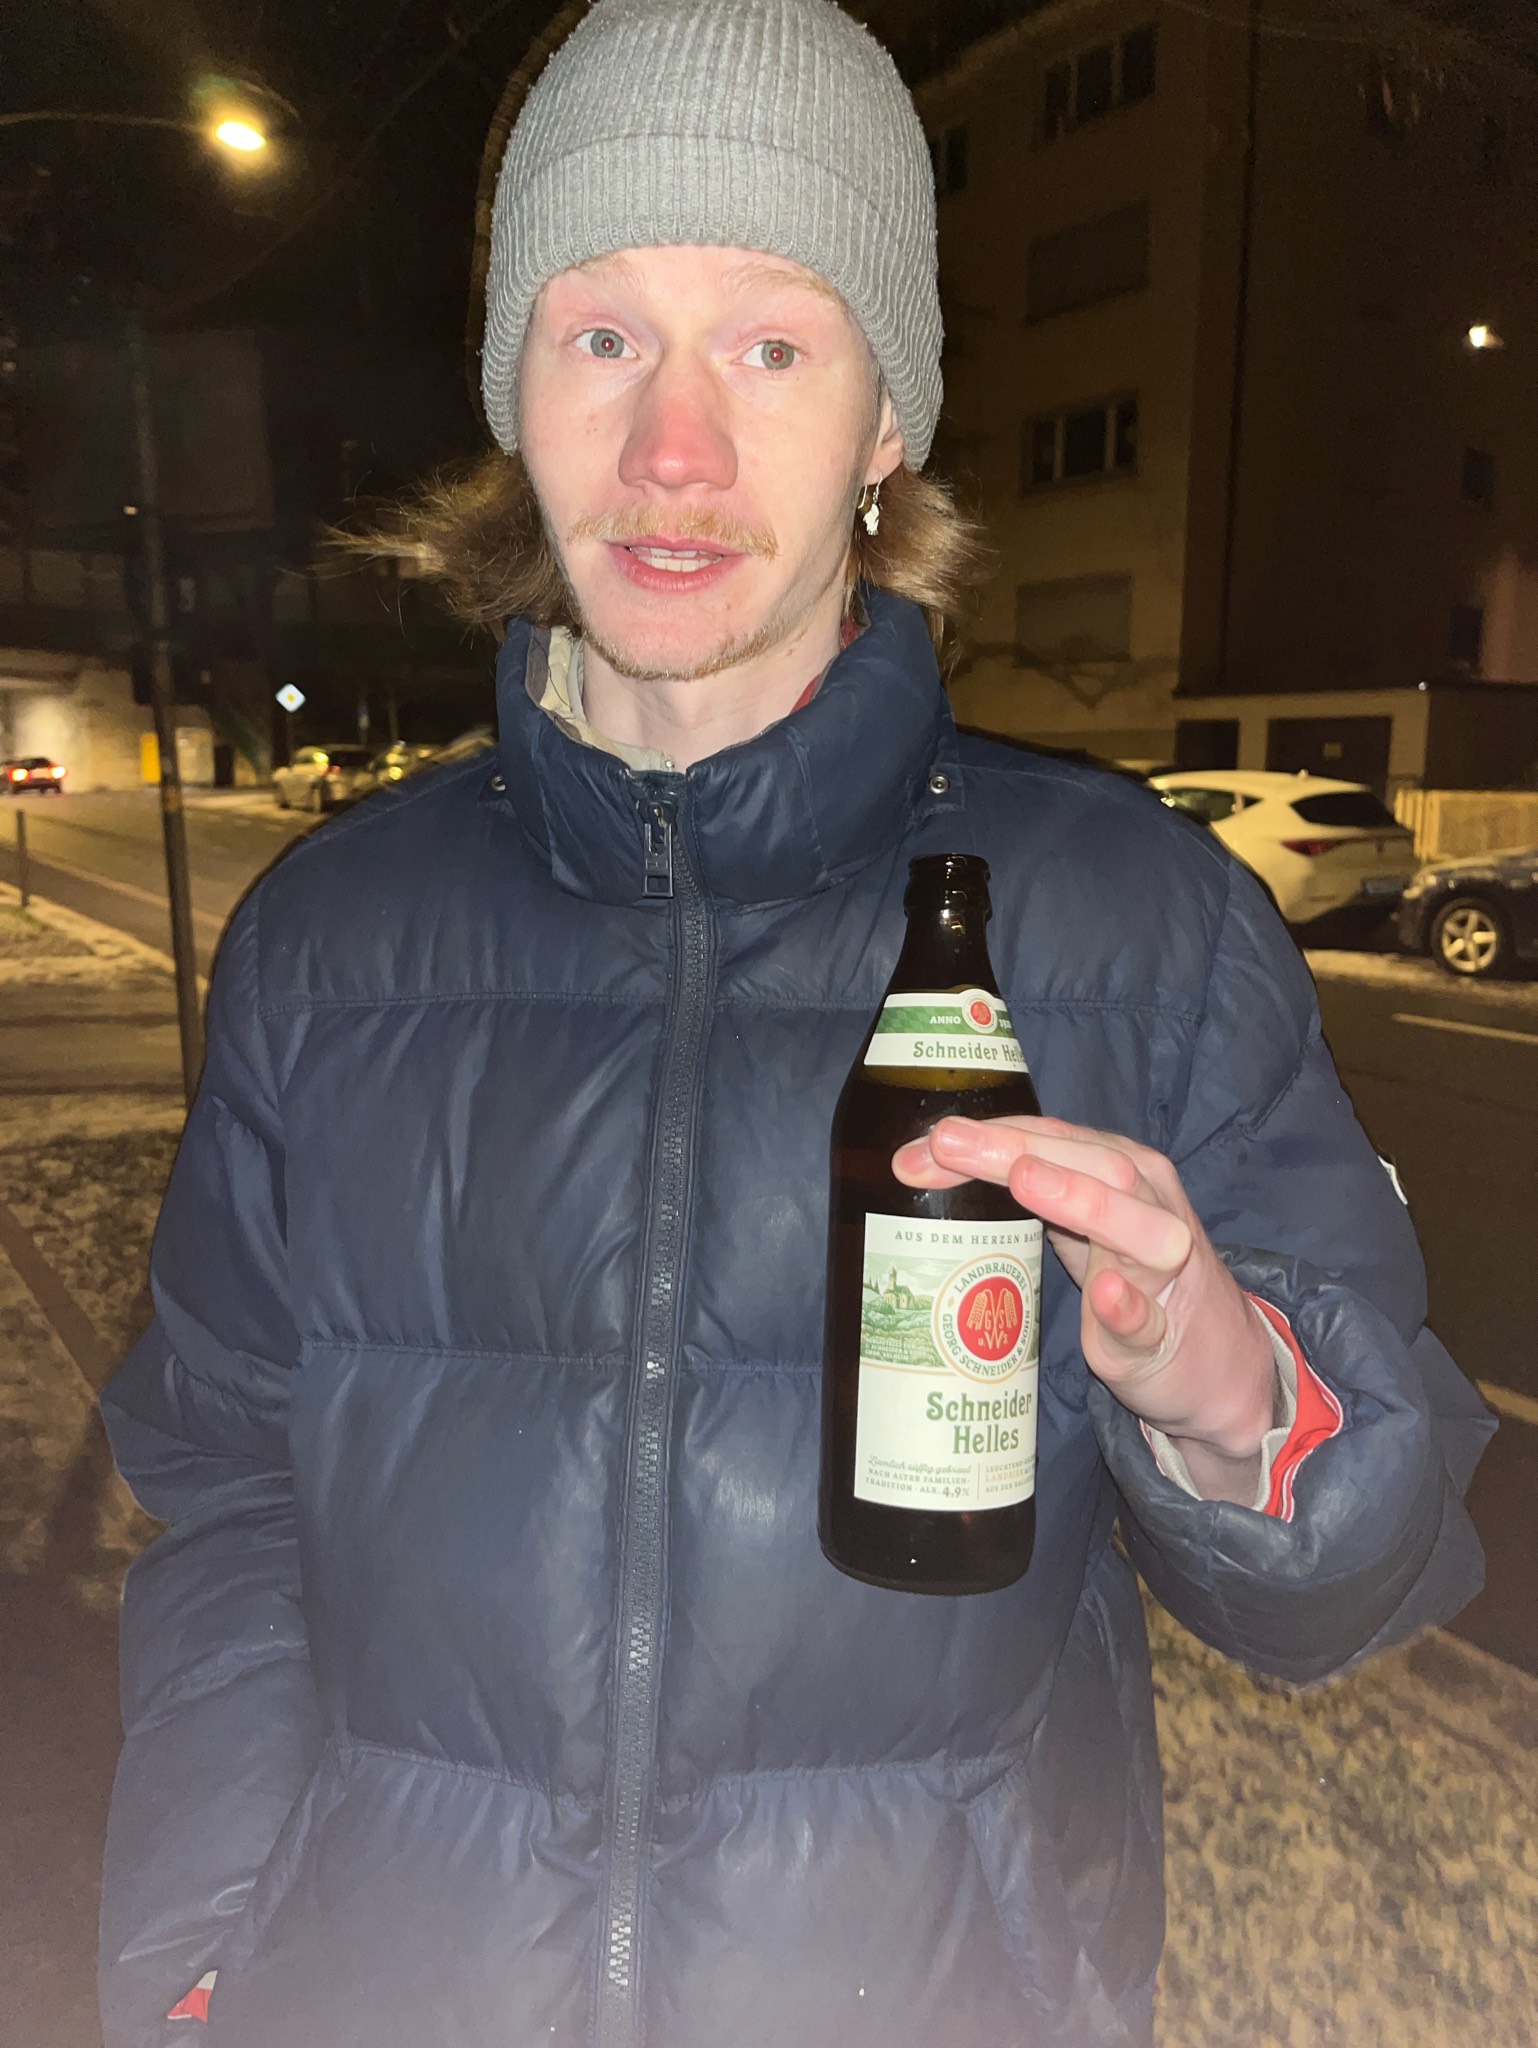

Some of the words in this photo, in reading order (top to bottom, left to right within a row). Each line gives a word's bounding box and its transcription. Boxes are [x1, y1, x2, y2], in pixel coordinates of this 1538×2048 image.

[929, 1015, 961, 1025] ANNO
[913, 1041, 998, 1060] Schneider
[895, 1230, 923, 1242] AUS
[931, 1234, 963, 1244] DEM
[971, 1233, 1020, 1245] HERZEN
[953, 1262, 1027, 1294] LANDBRAUEREI
[942, 1313, 962, 1356] GEORG
[959, 1354, 1018, 1377] SCHNEIDER
[1020, 1310, 1031, 1348] SOHN
[926, 1389, 1032, 1422] Schneider
[952, 1424, 1019, 1454] Helles
[868, 1455, 906, 1470] Ziemlich
[868, 1467, 890, 1479] NACH
[893, 1472, 920, 1482] ALTER
[923, 1476, 970, 1484] FAMILIEN-
[865, 1477, 912, 1491] TRADITION
[920, 1486, 940, 1494] ALK.
